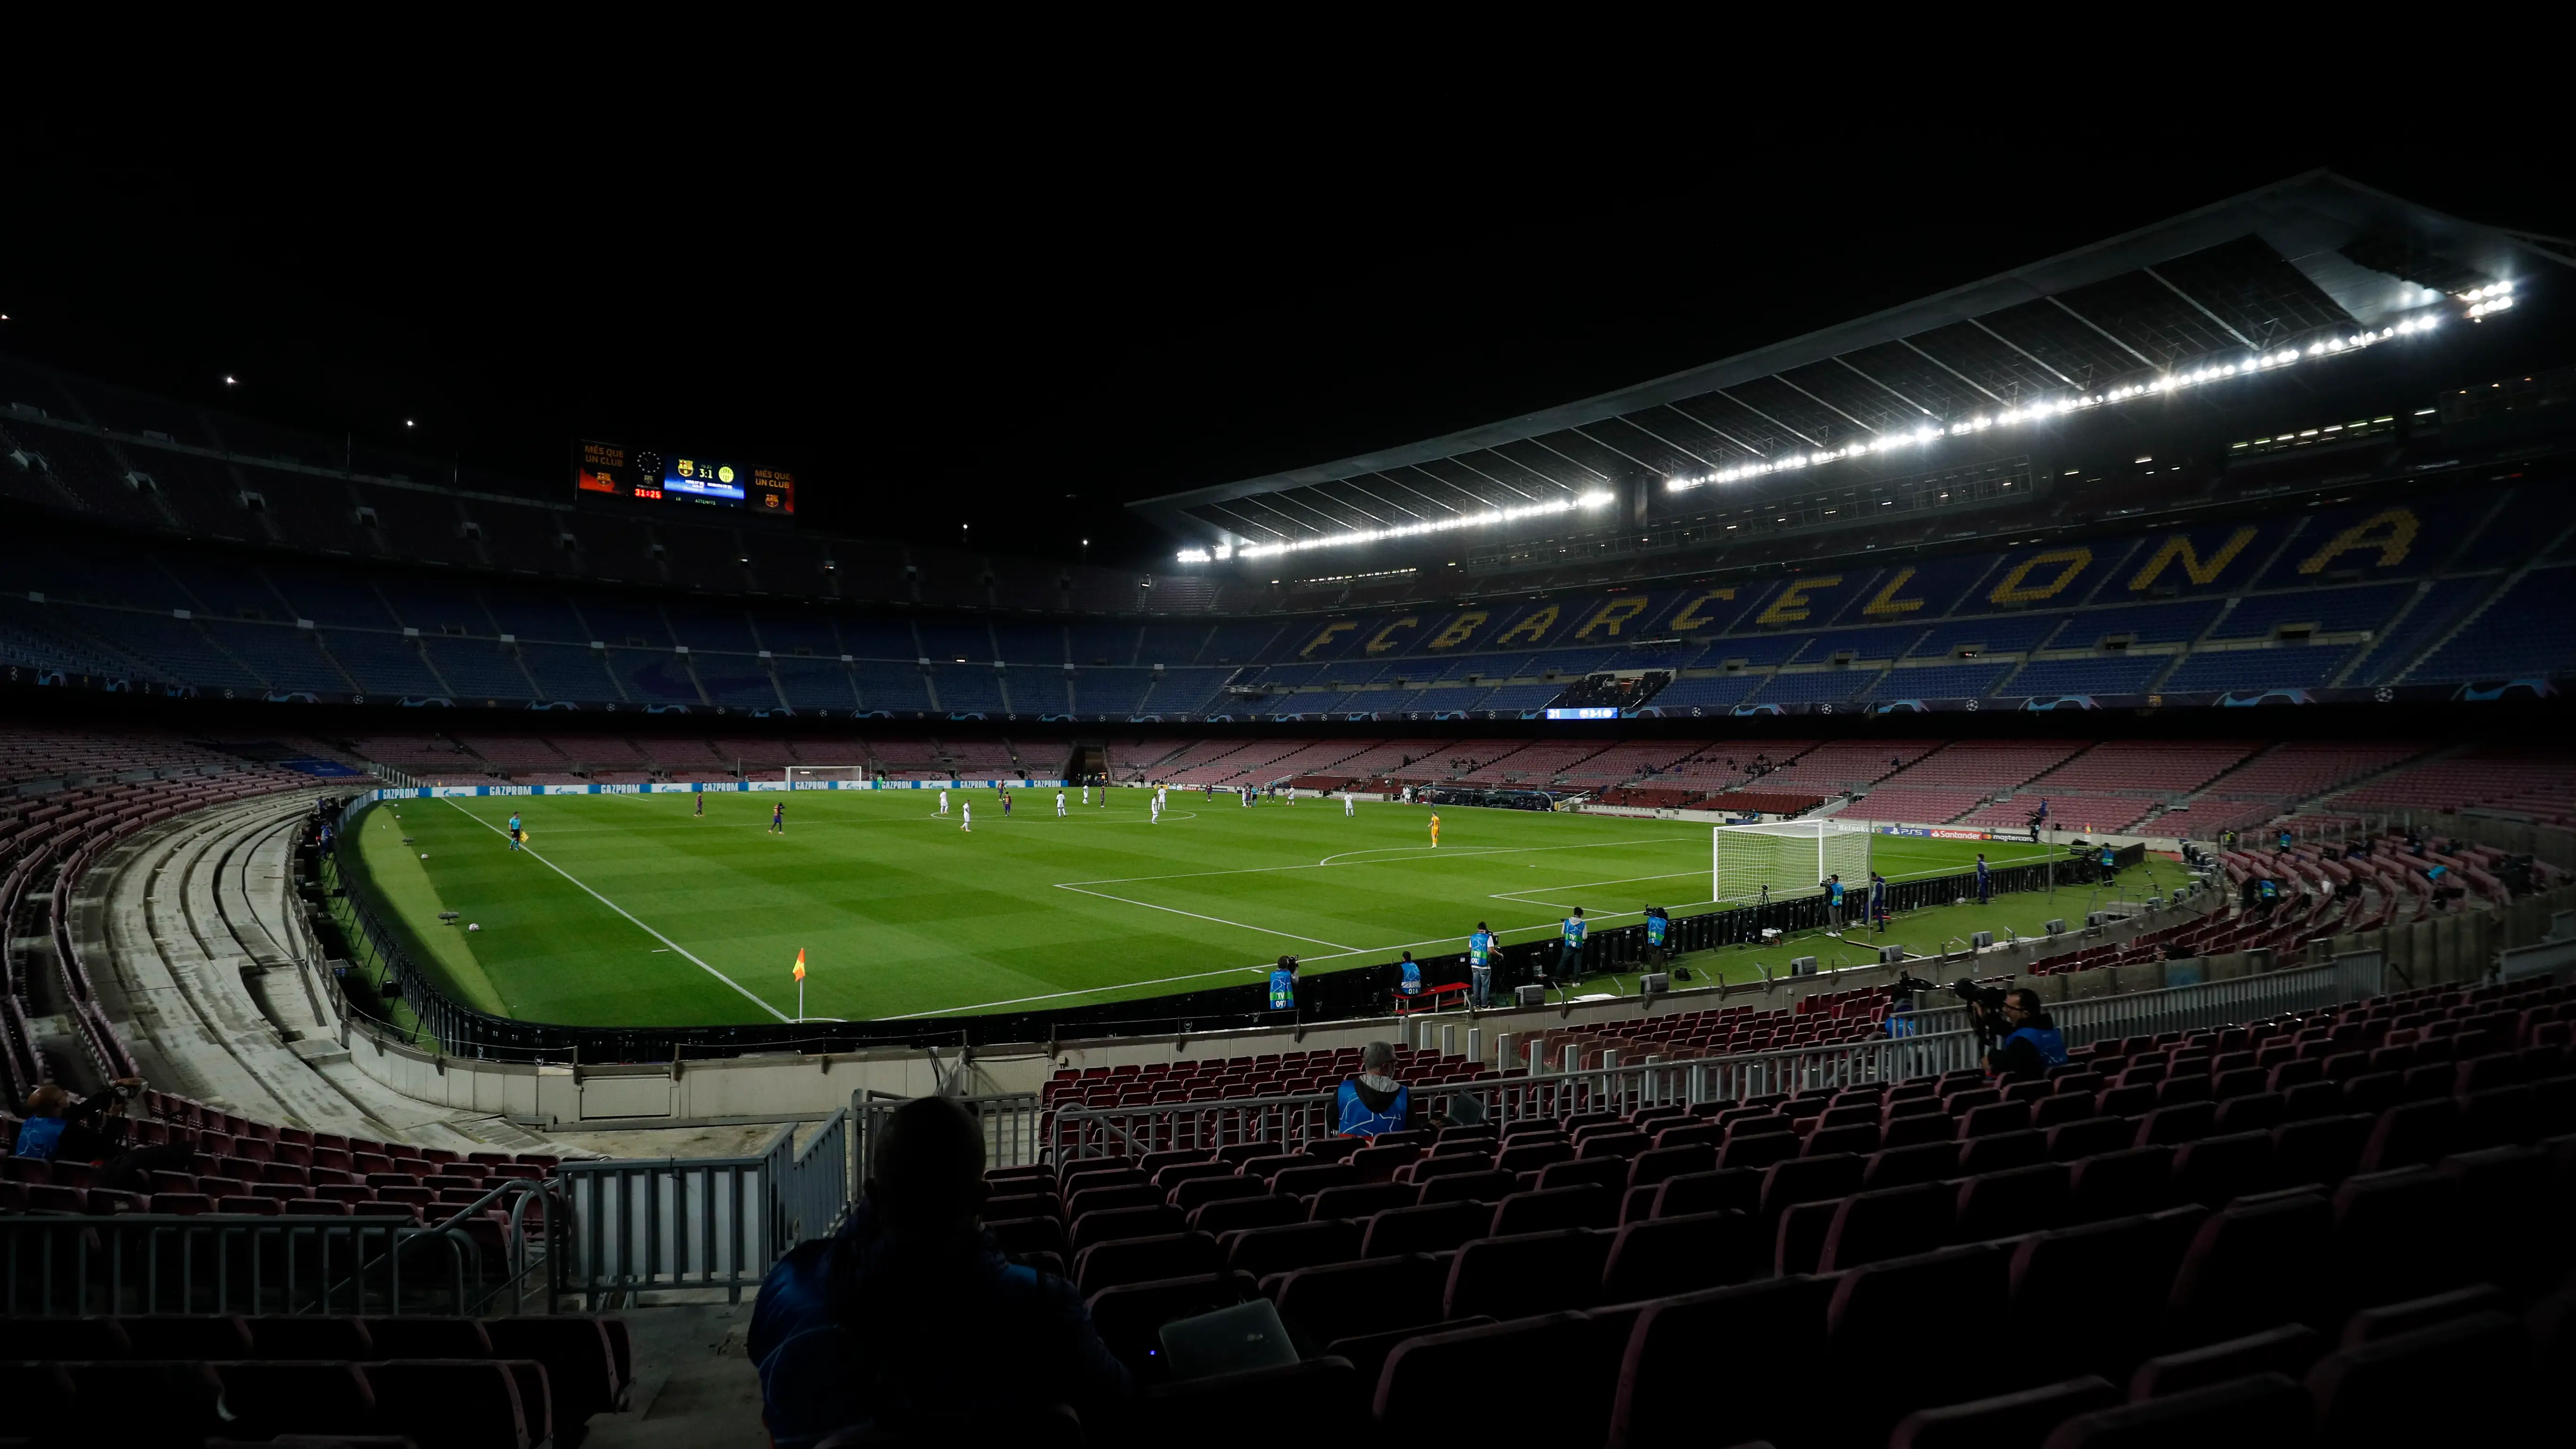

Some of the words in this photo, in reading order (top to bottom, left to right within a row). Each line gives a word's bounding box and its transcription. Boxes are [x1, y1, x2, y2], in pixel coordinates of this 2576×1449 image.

[585, 444, 604, 455] MÉS
[606, 449, 624, 458] QUE
[585, 455, 598, 463] UN
[600, 457, 623, 467] CLUB
[699, 468, 713, 479] 3:1
[755, 469, 772, 478] MÉS
[774, 472, 790, 480] QUE
[755, 478, 767, 486] UN
[769, 480, 789, 488] CLUB
[635, 488, 662, 499] 31:25
[1299, 616, 1418, 657] FC
[1429, 507, 2421, 649] BARCELONA
[601, 784, 640, 794] GAZPROM
[702, 782, 739, 791] GAZPROM
[795, 781, 829, 790] GAZPROM
[882, 781, 912, 789] GAZPROM
[960, 781, 988, 789] GAZPROM
[383, 788, 419, 799] GAZPROM
[489, 786, 532, 796] GAZPROM
[1940, 831, 1981, 840] Santander
